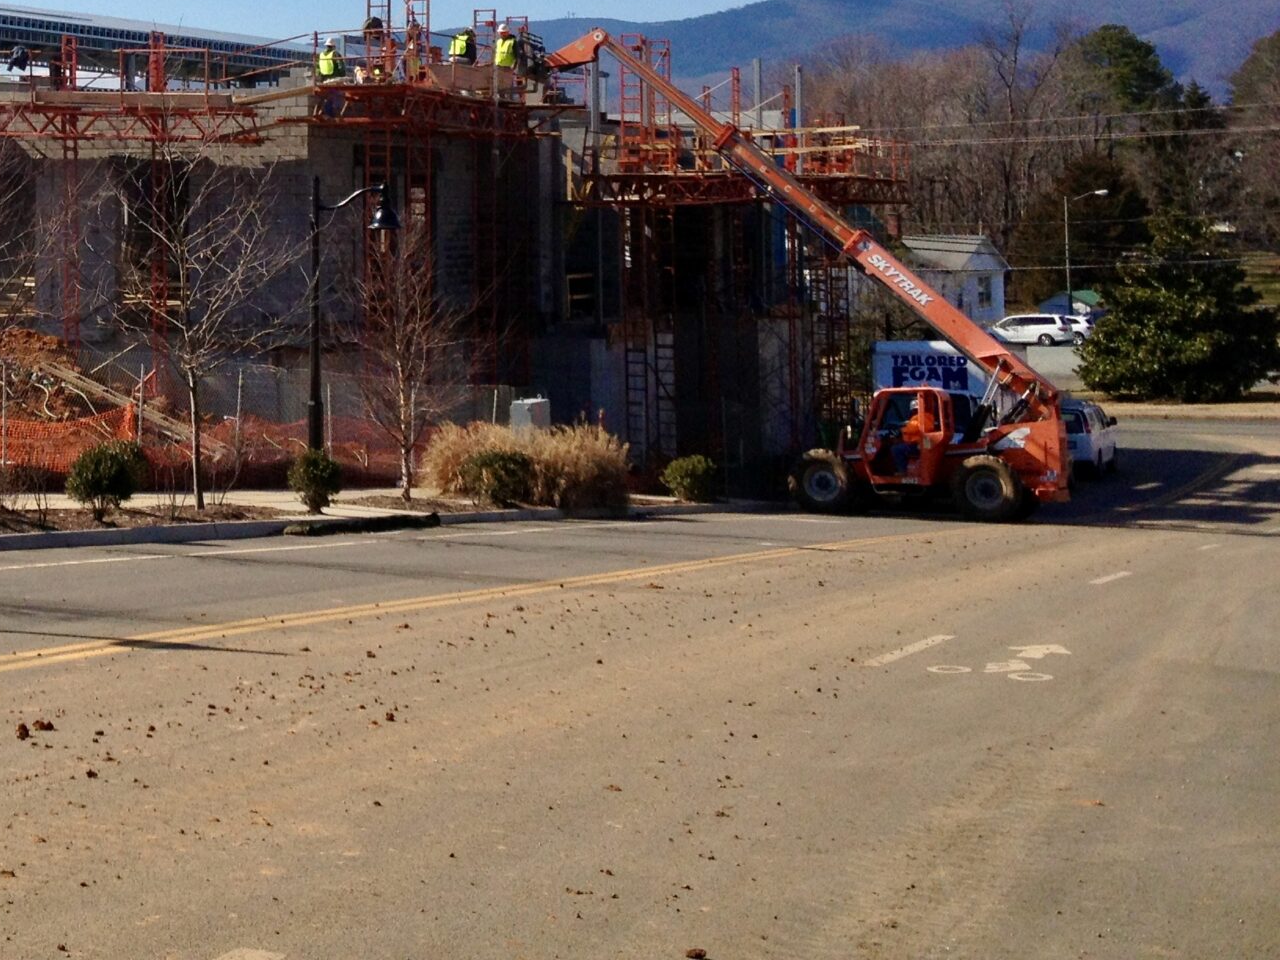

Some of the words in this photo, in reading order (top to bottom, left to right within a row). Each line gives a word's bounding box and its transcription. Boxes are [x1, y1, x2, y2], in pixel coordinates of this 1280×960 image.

[867, 254, 934, 307] SKYTRAK
[891, 355, 968, 367] TAILORED
[892, 367, 969, 390] FOAM
